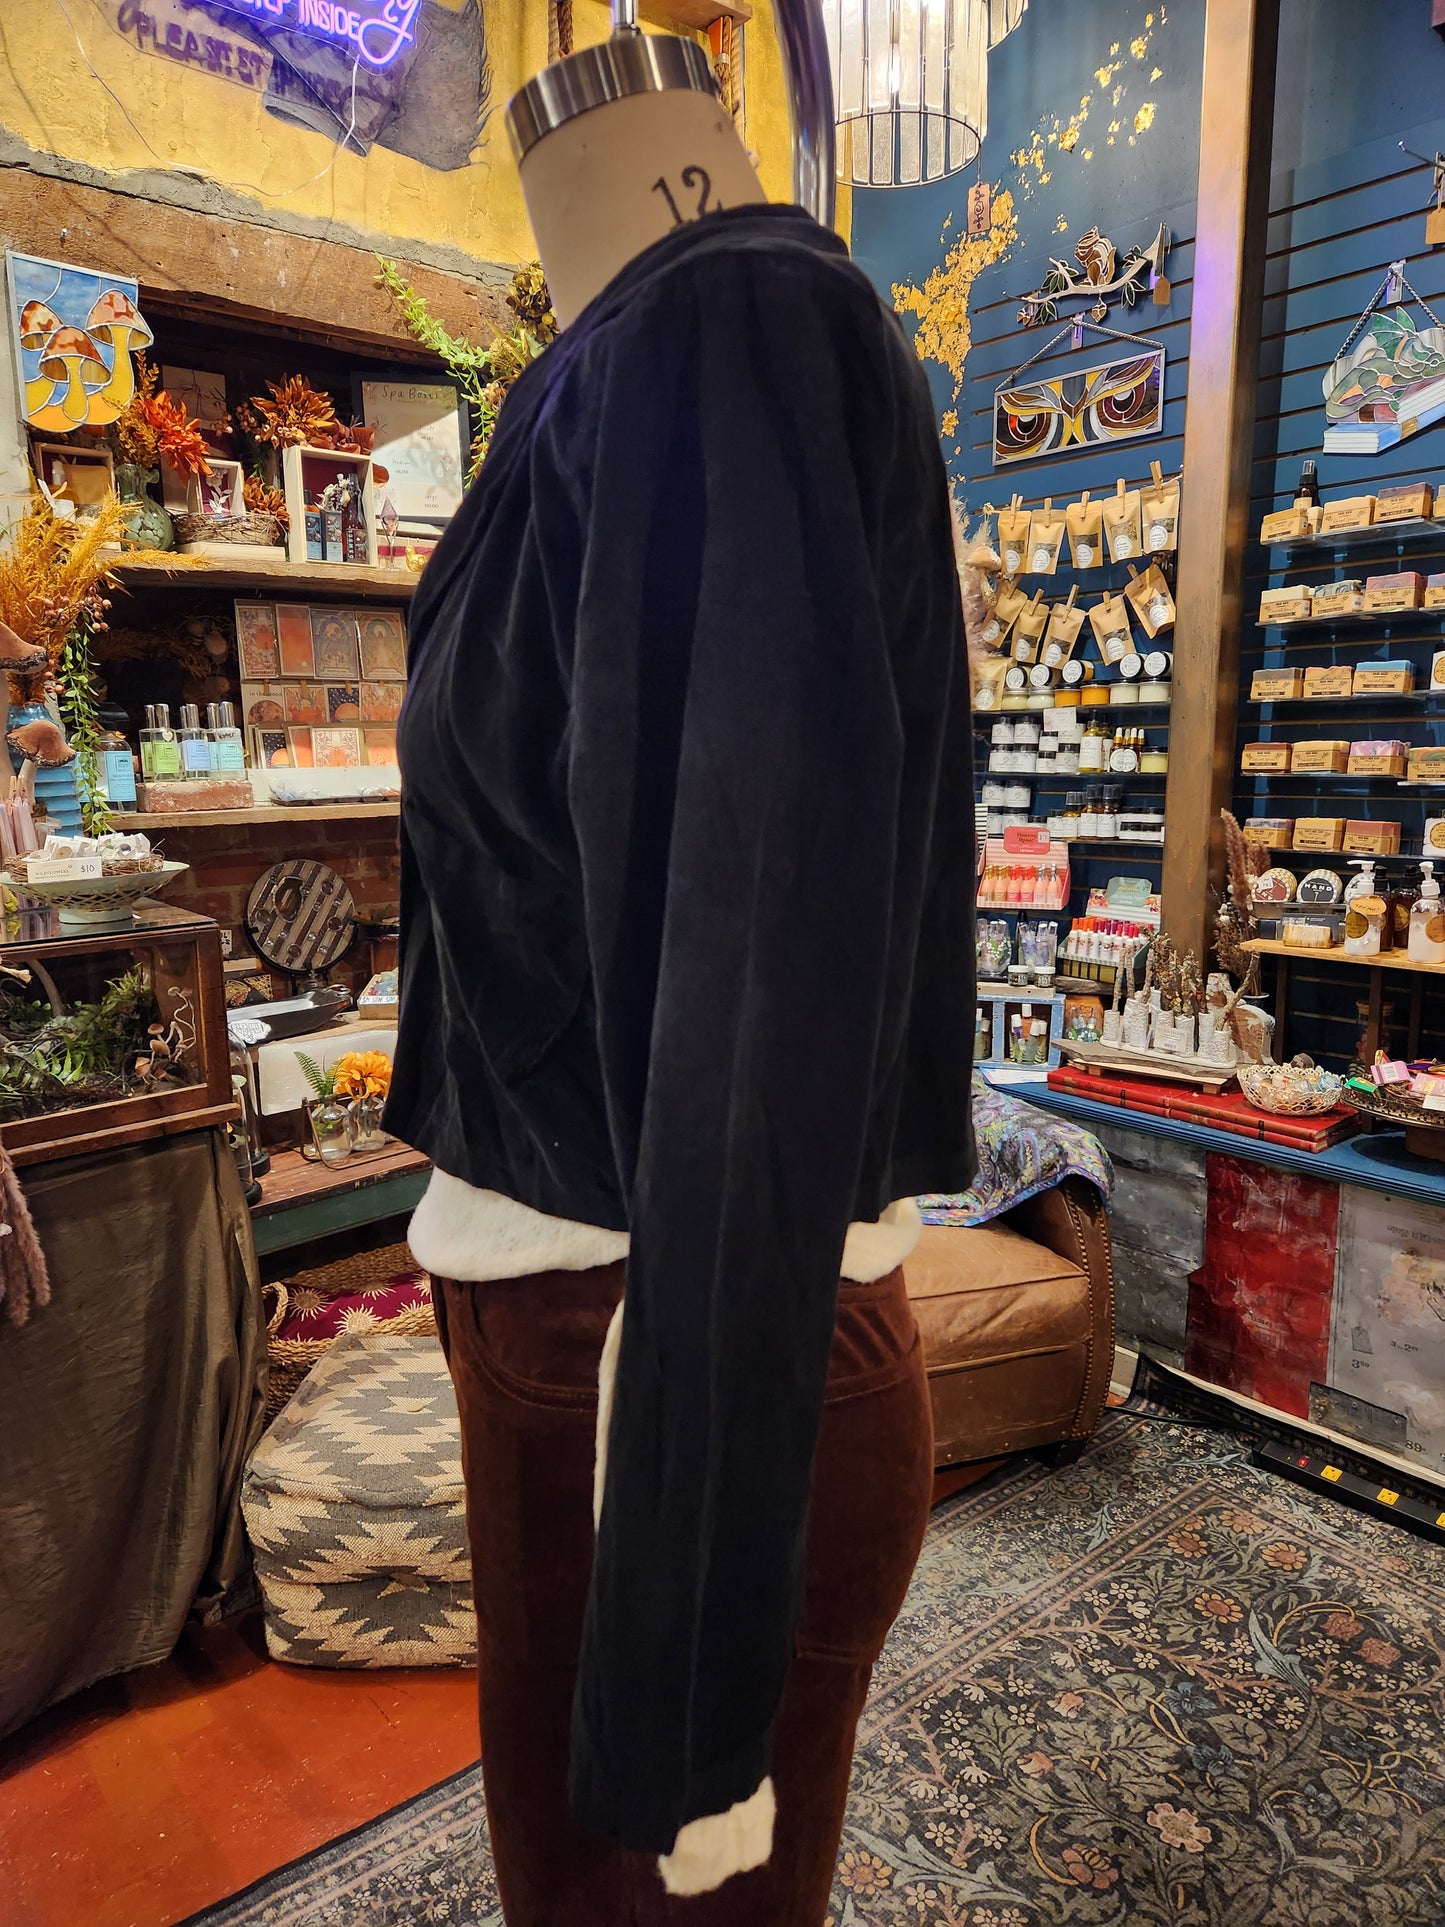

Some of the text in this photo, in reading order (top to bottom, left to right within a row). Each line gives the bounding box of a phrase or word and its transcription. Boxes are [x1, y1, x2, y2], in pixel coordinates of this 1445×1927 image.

[298, 0, 361, 41] INSIDE
[650, 164, 711, 223] 12
[382, 385, 403, 402] Spa
[80, 864, 95, 873] $10
[1304, 882, 1333, 893] HAND
